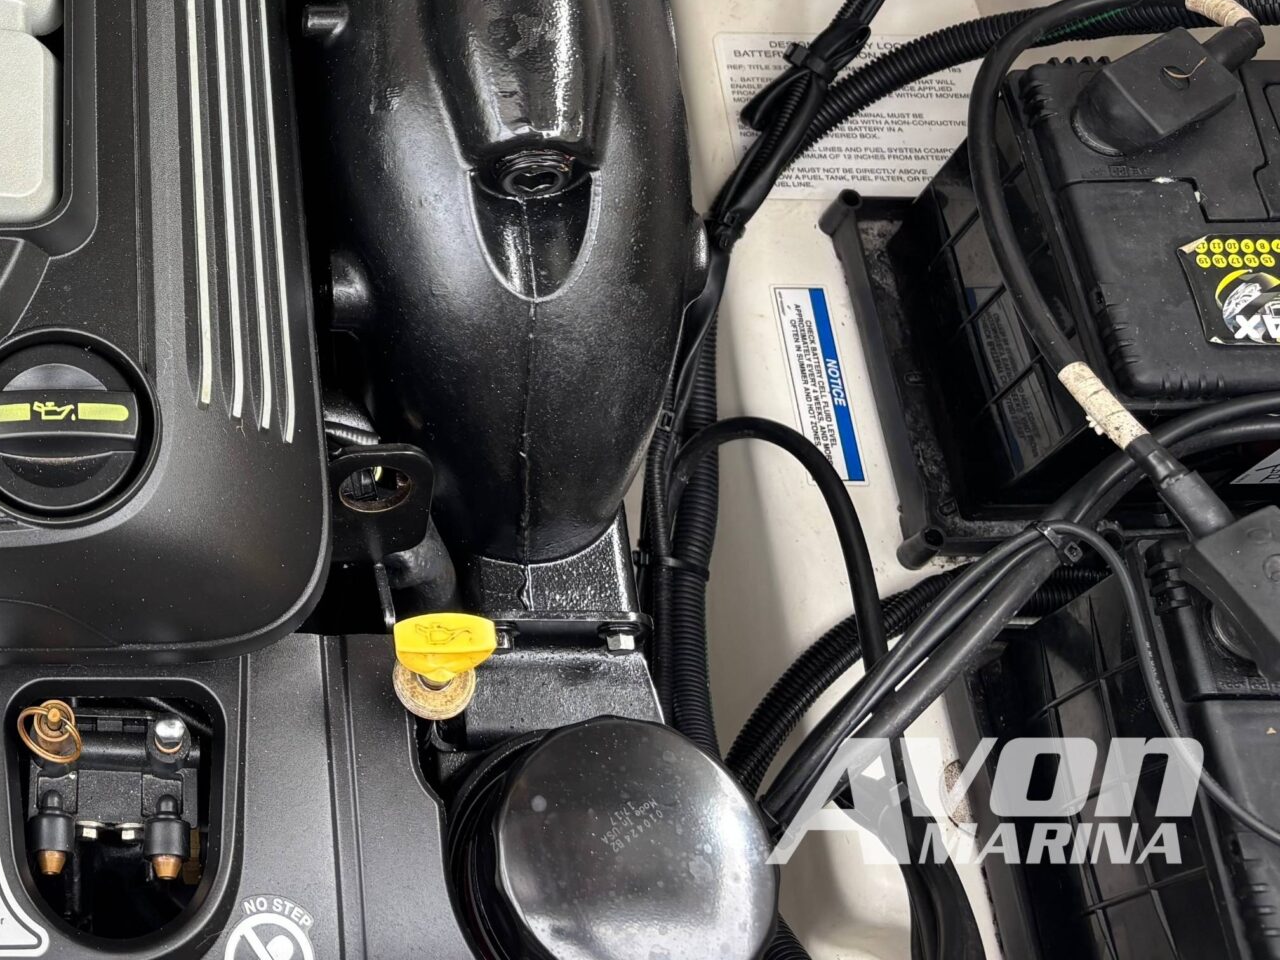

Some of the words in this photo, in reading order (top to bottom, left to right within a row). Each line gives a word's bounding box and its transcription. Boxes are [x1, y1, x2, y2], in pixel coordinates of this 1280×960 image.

[805, 320, 816, 344] CHECK
[811, 346, 824, 380] BATTERY
[826, 359, 846, 407] NOTICE
[822, 401, 832, 422] FLUID
[826, 424, 837, 448] LEVEL
[244, 897, 267, 914] NO
[272, 898, 312, 926] STEP
